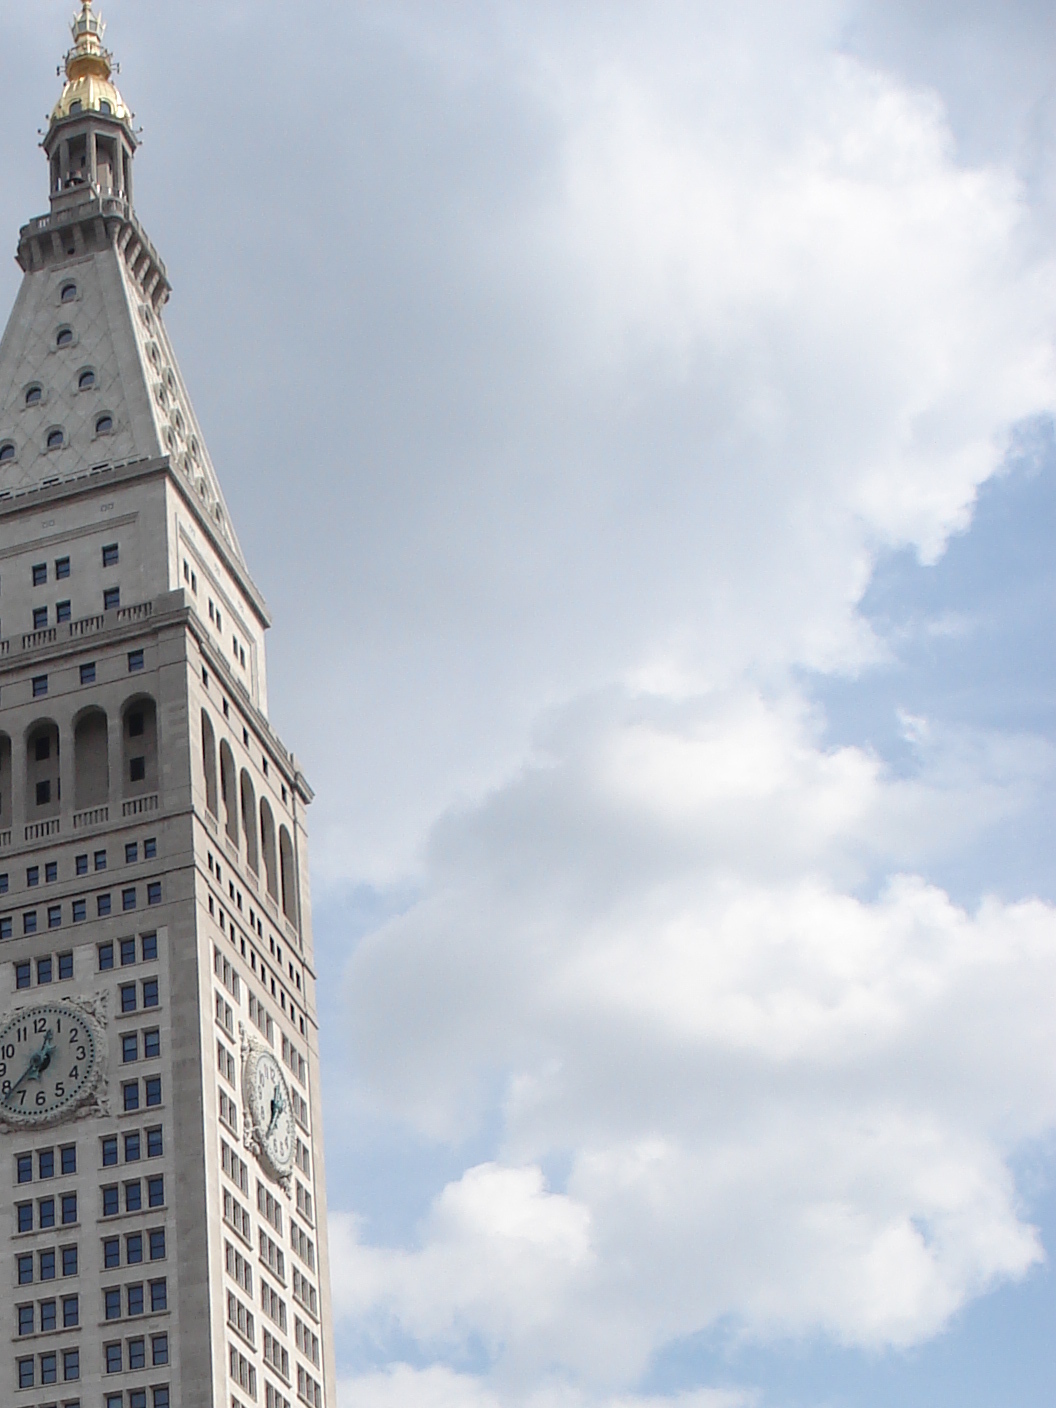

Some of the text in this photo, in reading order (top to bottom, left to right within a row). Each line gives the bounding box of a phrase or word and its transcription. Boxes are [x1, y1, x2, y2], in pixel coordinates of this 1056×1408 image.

[33, 1018, 47, 1034] 12
[56, 1018, 61, 1034] 1
[17, 1027, 27, 1042] 11
[69, 1028, 79, 1043] 2
[1, 1044, 15, 1060] 10
[76, 1046, 86, 1060] 3
[69, 1065, 79, 1079] 4
[2, 1080, 12, 1095] 8
[55, 1083, 65, 1097] 5
[17, 1090, 27, 1105] 7
[35, 1091, 46, 1106] 6
